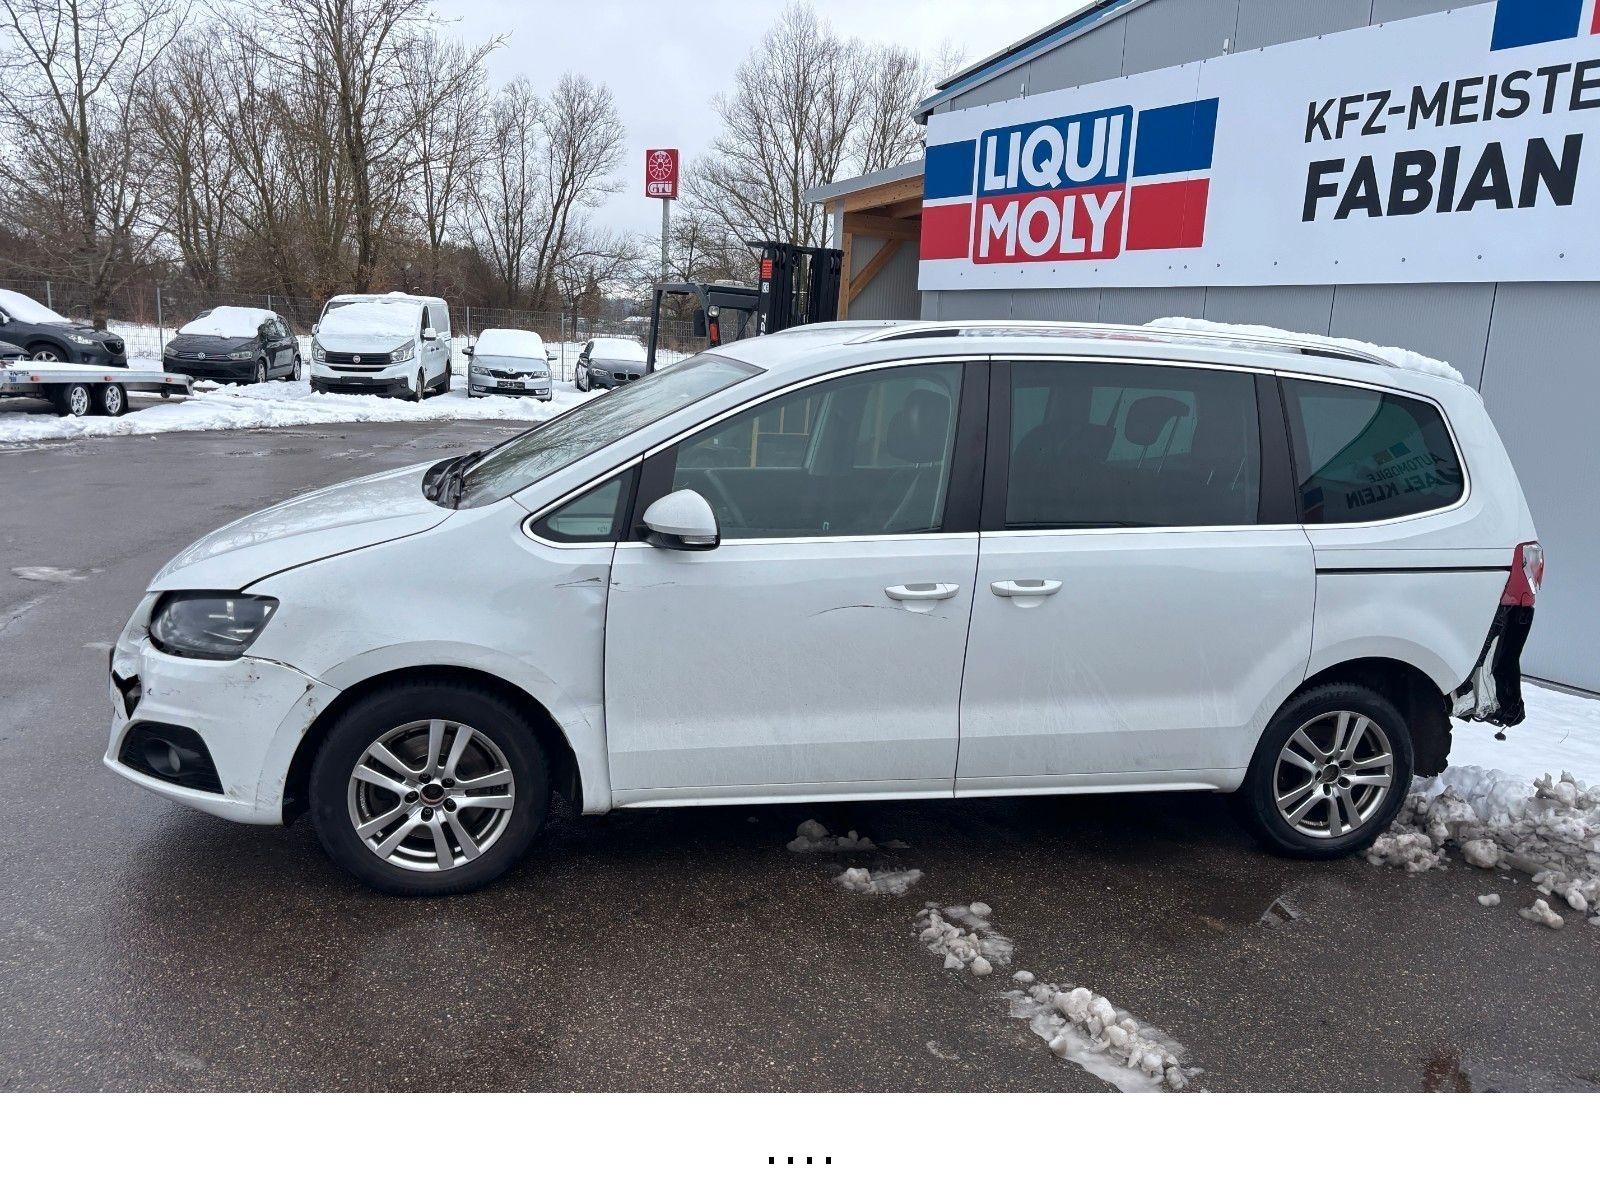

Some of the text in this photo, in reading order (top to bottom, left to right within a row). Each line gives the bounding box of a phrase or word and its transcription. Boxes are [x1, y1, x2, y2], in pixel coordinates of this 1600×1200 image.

[984, 114, 1124, 190] LIQUI
[1302, 133, 1583, 222] FABIAN
[980, 191, 1123, 257] MOLY
